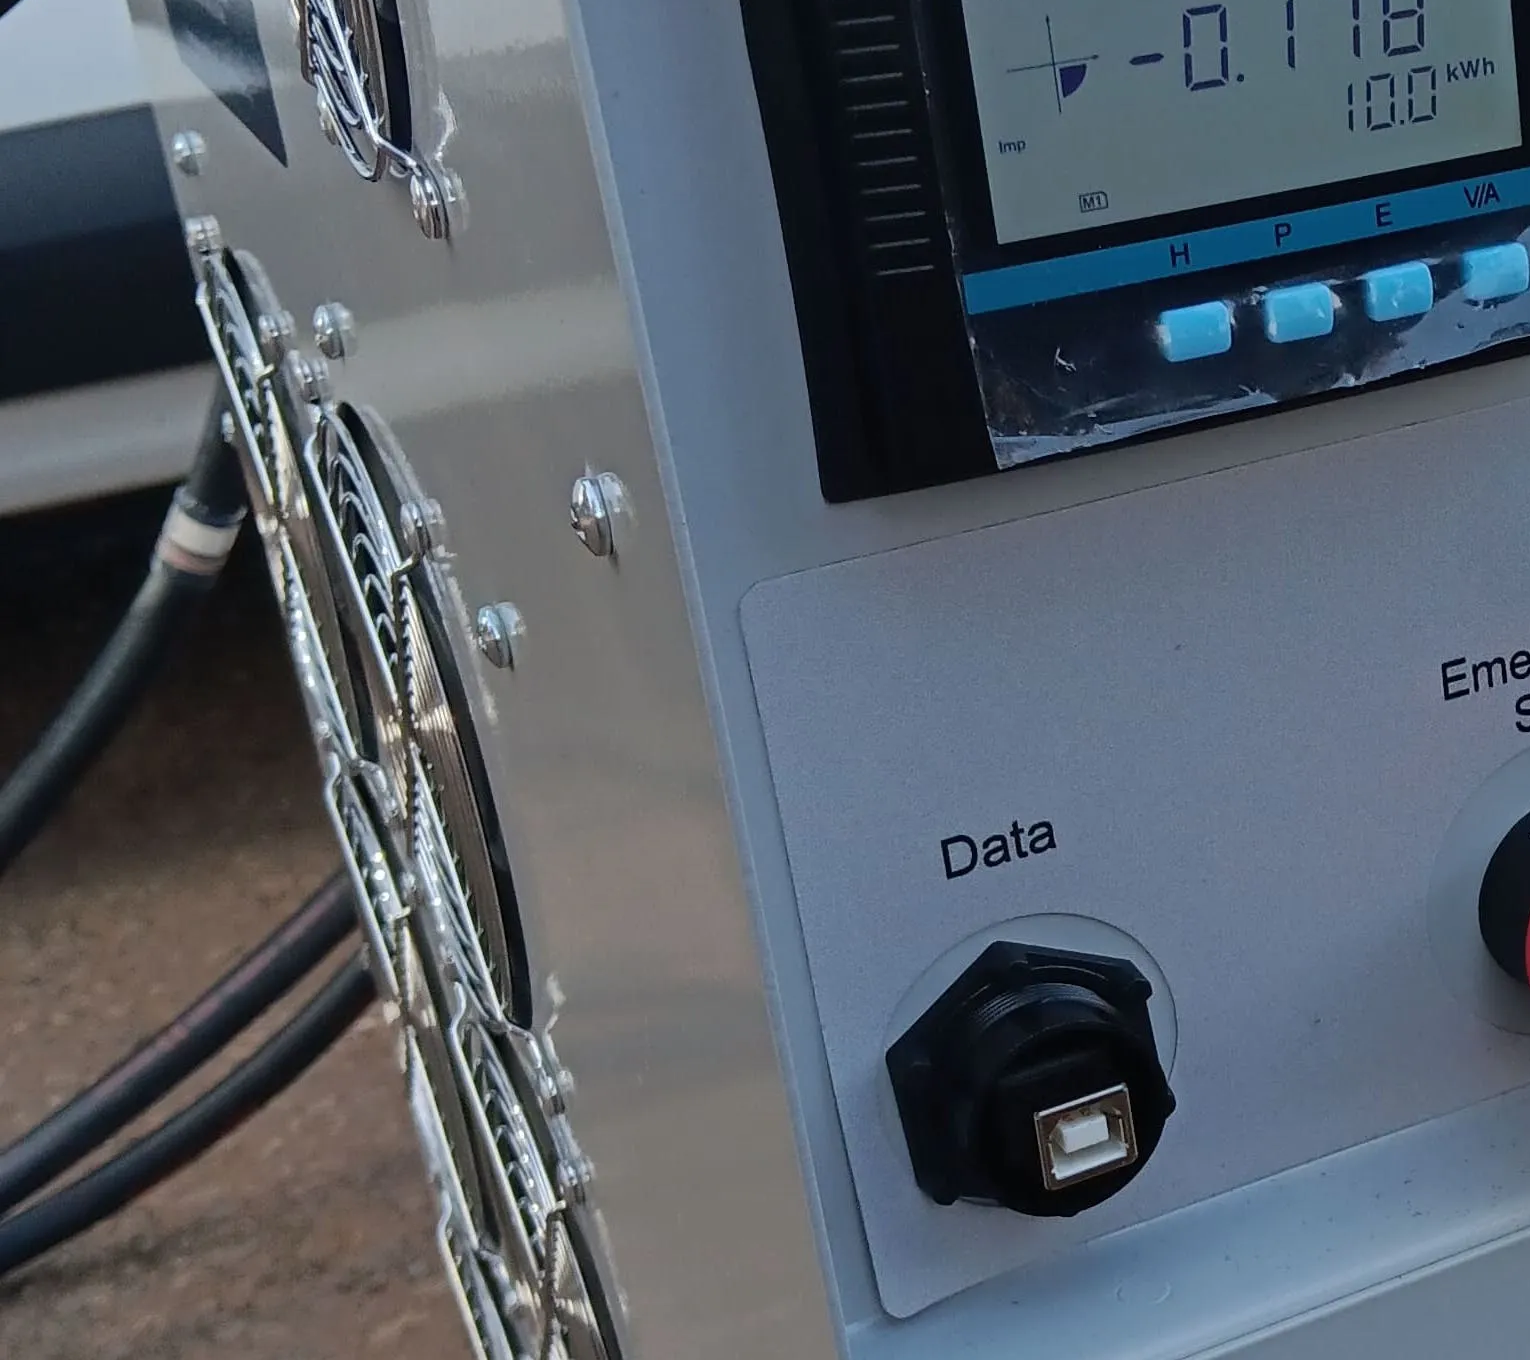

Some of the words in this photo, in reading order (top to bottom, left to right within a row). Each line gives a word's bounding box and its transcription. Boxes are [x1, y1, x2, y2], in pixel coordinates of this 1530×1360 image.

[1446, 57, 1495, 82] kWh
[998, 139, 1026, 156] Imp
[1463, 182, 1500, 210] V/A
[1376, 202, 1392, 227] E
[1274, 221, 1292, 248] P
[1170, 243, 1190, 268] H
[940, 820, 1056, 879] Data
